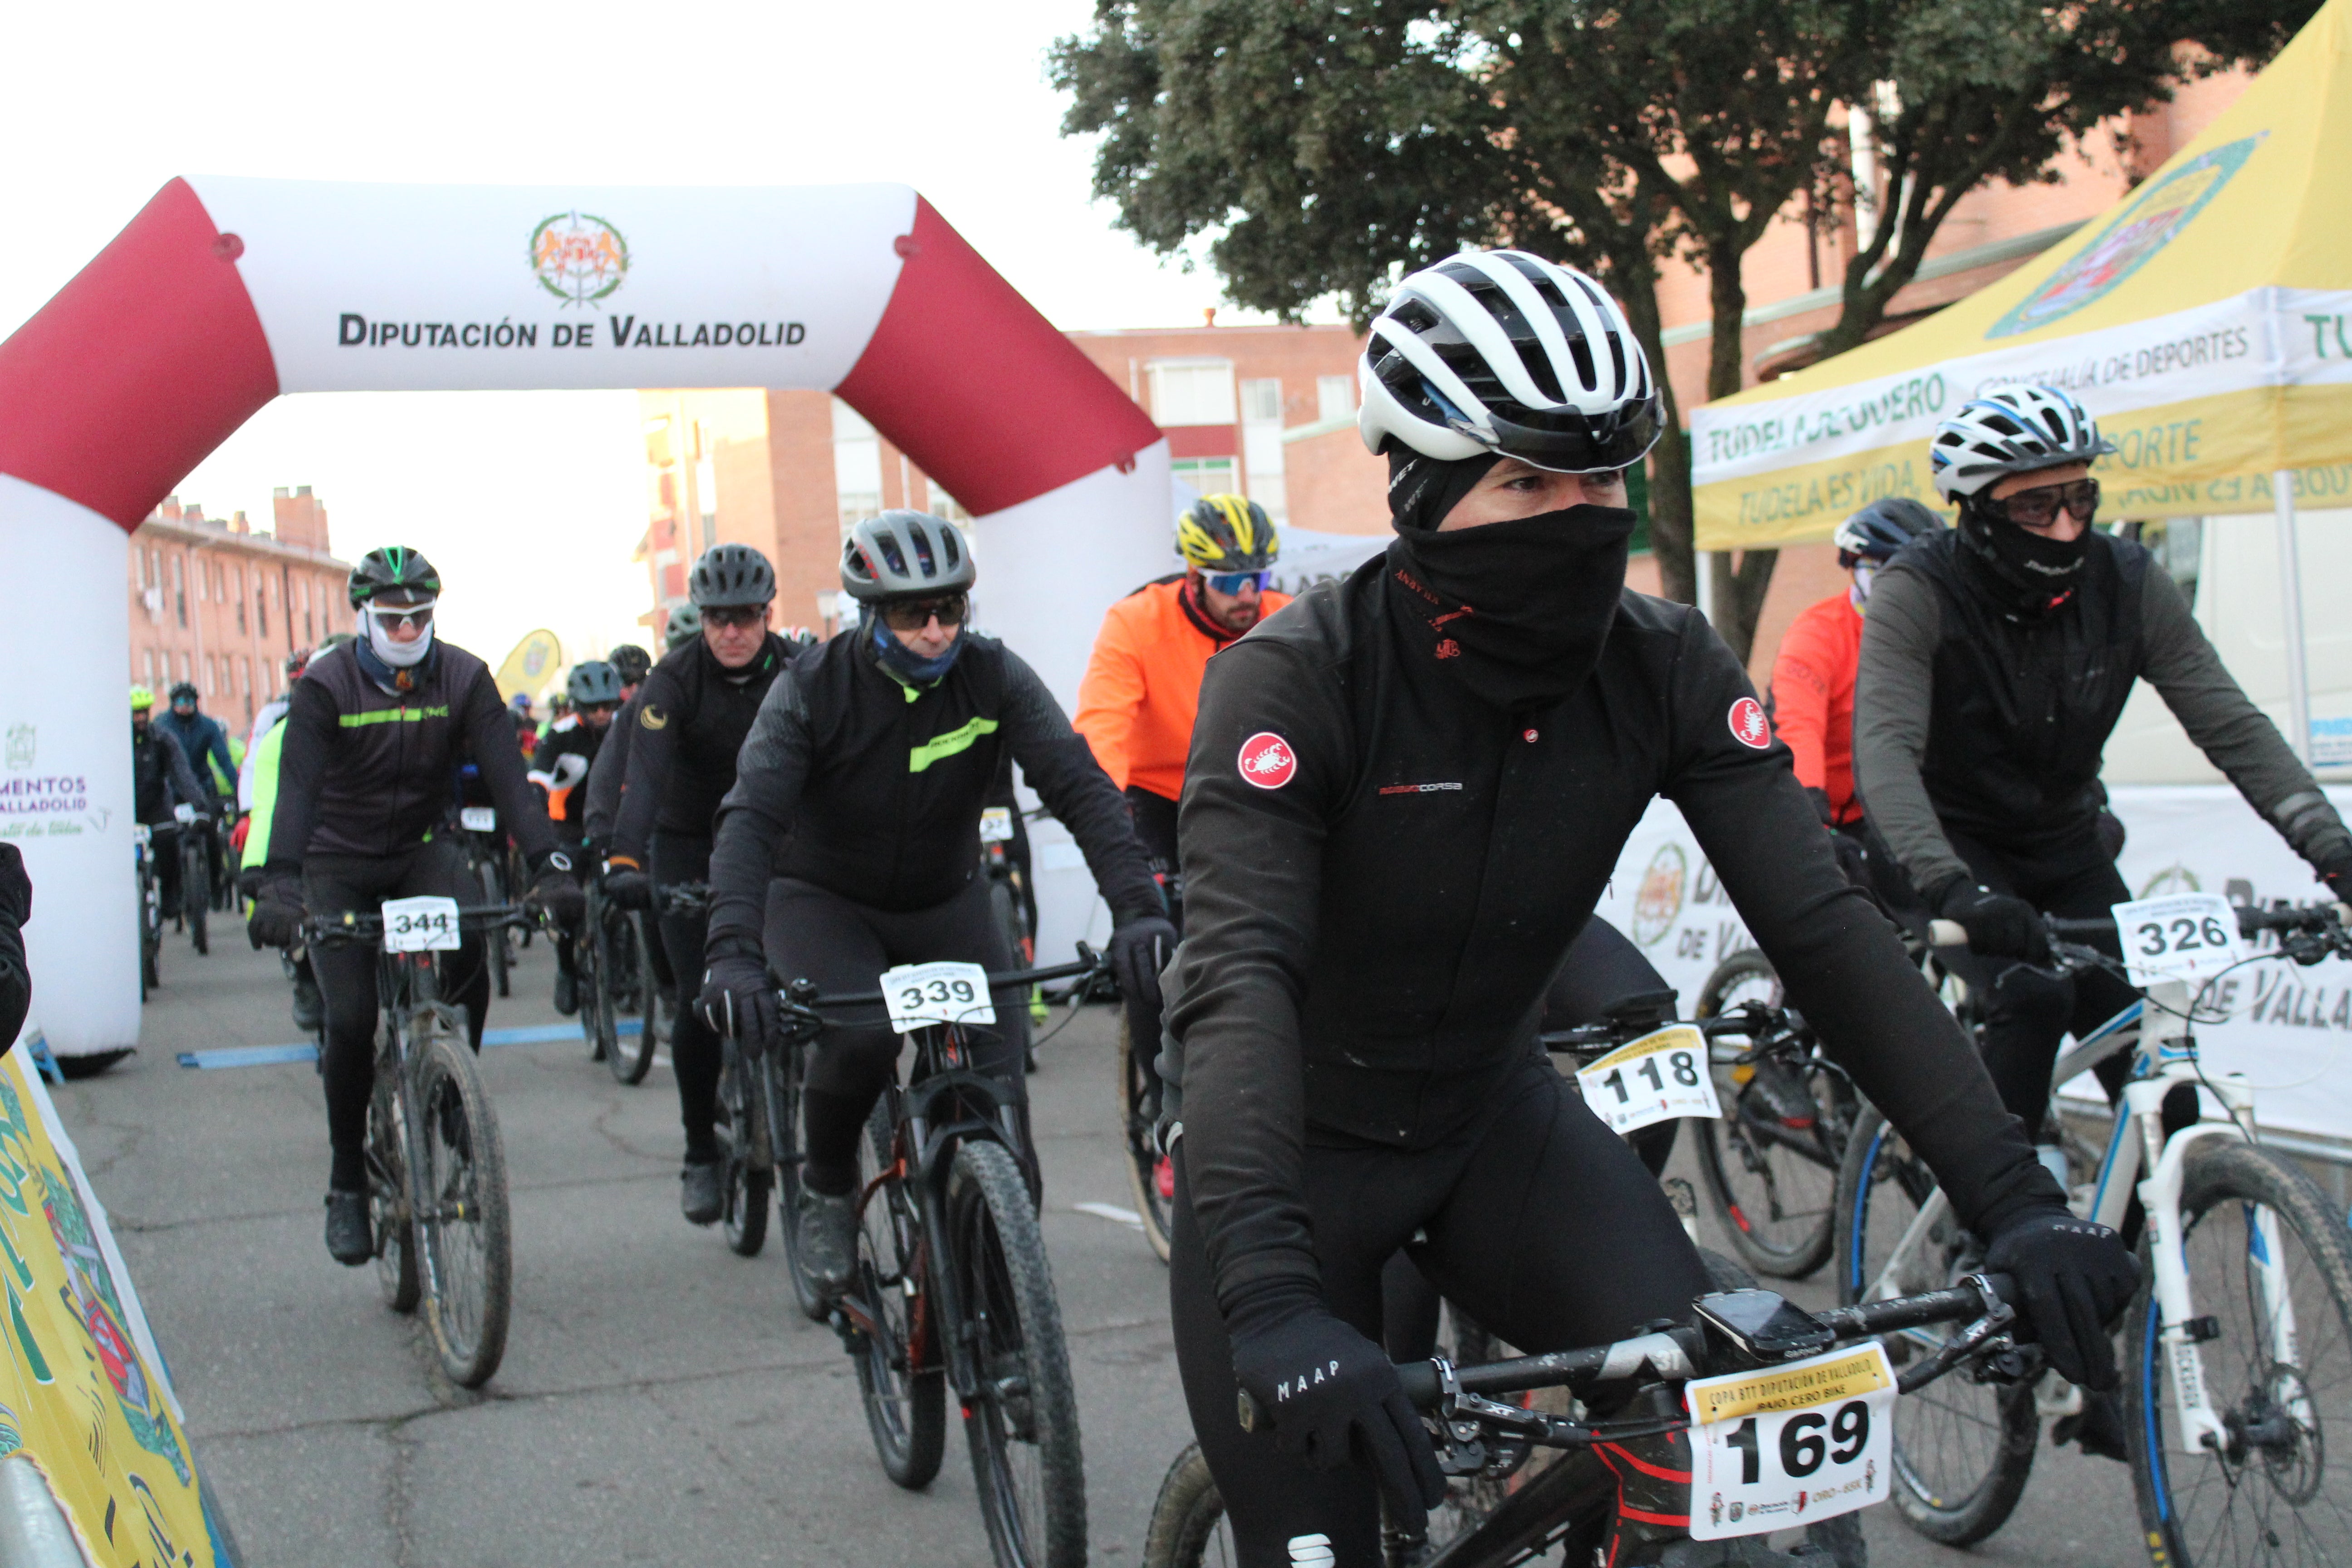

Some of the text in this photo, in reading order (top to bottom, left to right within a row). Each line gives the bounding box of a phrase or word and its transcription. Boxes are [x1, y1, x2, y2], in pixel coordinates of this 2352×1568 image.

[2103, 353, 2132, 384] DE
[2136, 326, 2249, 378] DEPORTES
[1740, 479, 1824, 525] TUDELA
[1828, 470, 1854, 509] ES
[394, 913, 448, 933] 344
[2137, 917, 2227, 956] 326
[901, 980, 975, 1010] 339
[1602, 1052, 1699, 1104] 118
[1277, 1360, 1339, 1402] MAAP
[1710, 1389, 1736, 1406] COPA
[1739, 1385, 1757, 1401] BTT
[2176, 1342, 2200, 1410] OCKSHOX
[1485, 1405, 1515, 1416] XT
[1790, 1391, 1821, 1406] CERO
[1725, 1400, 1870, 1485] 169
